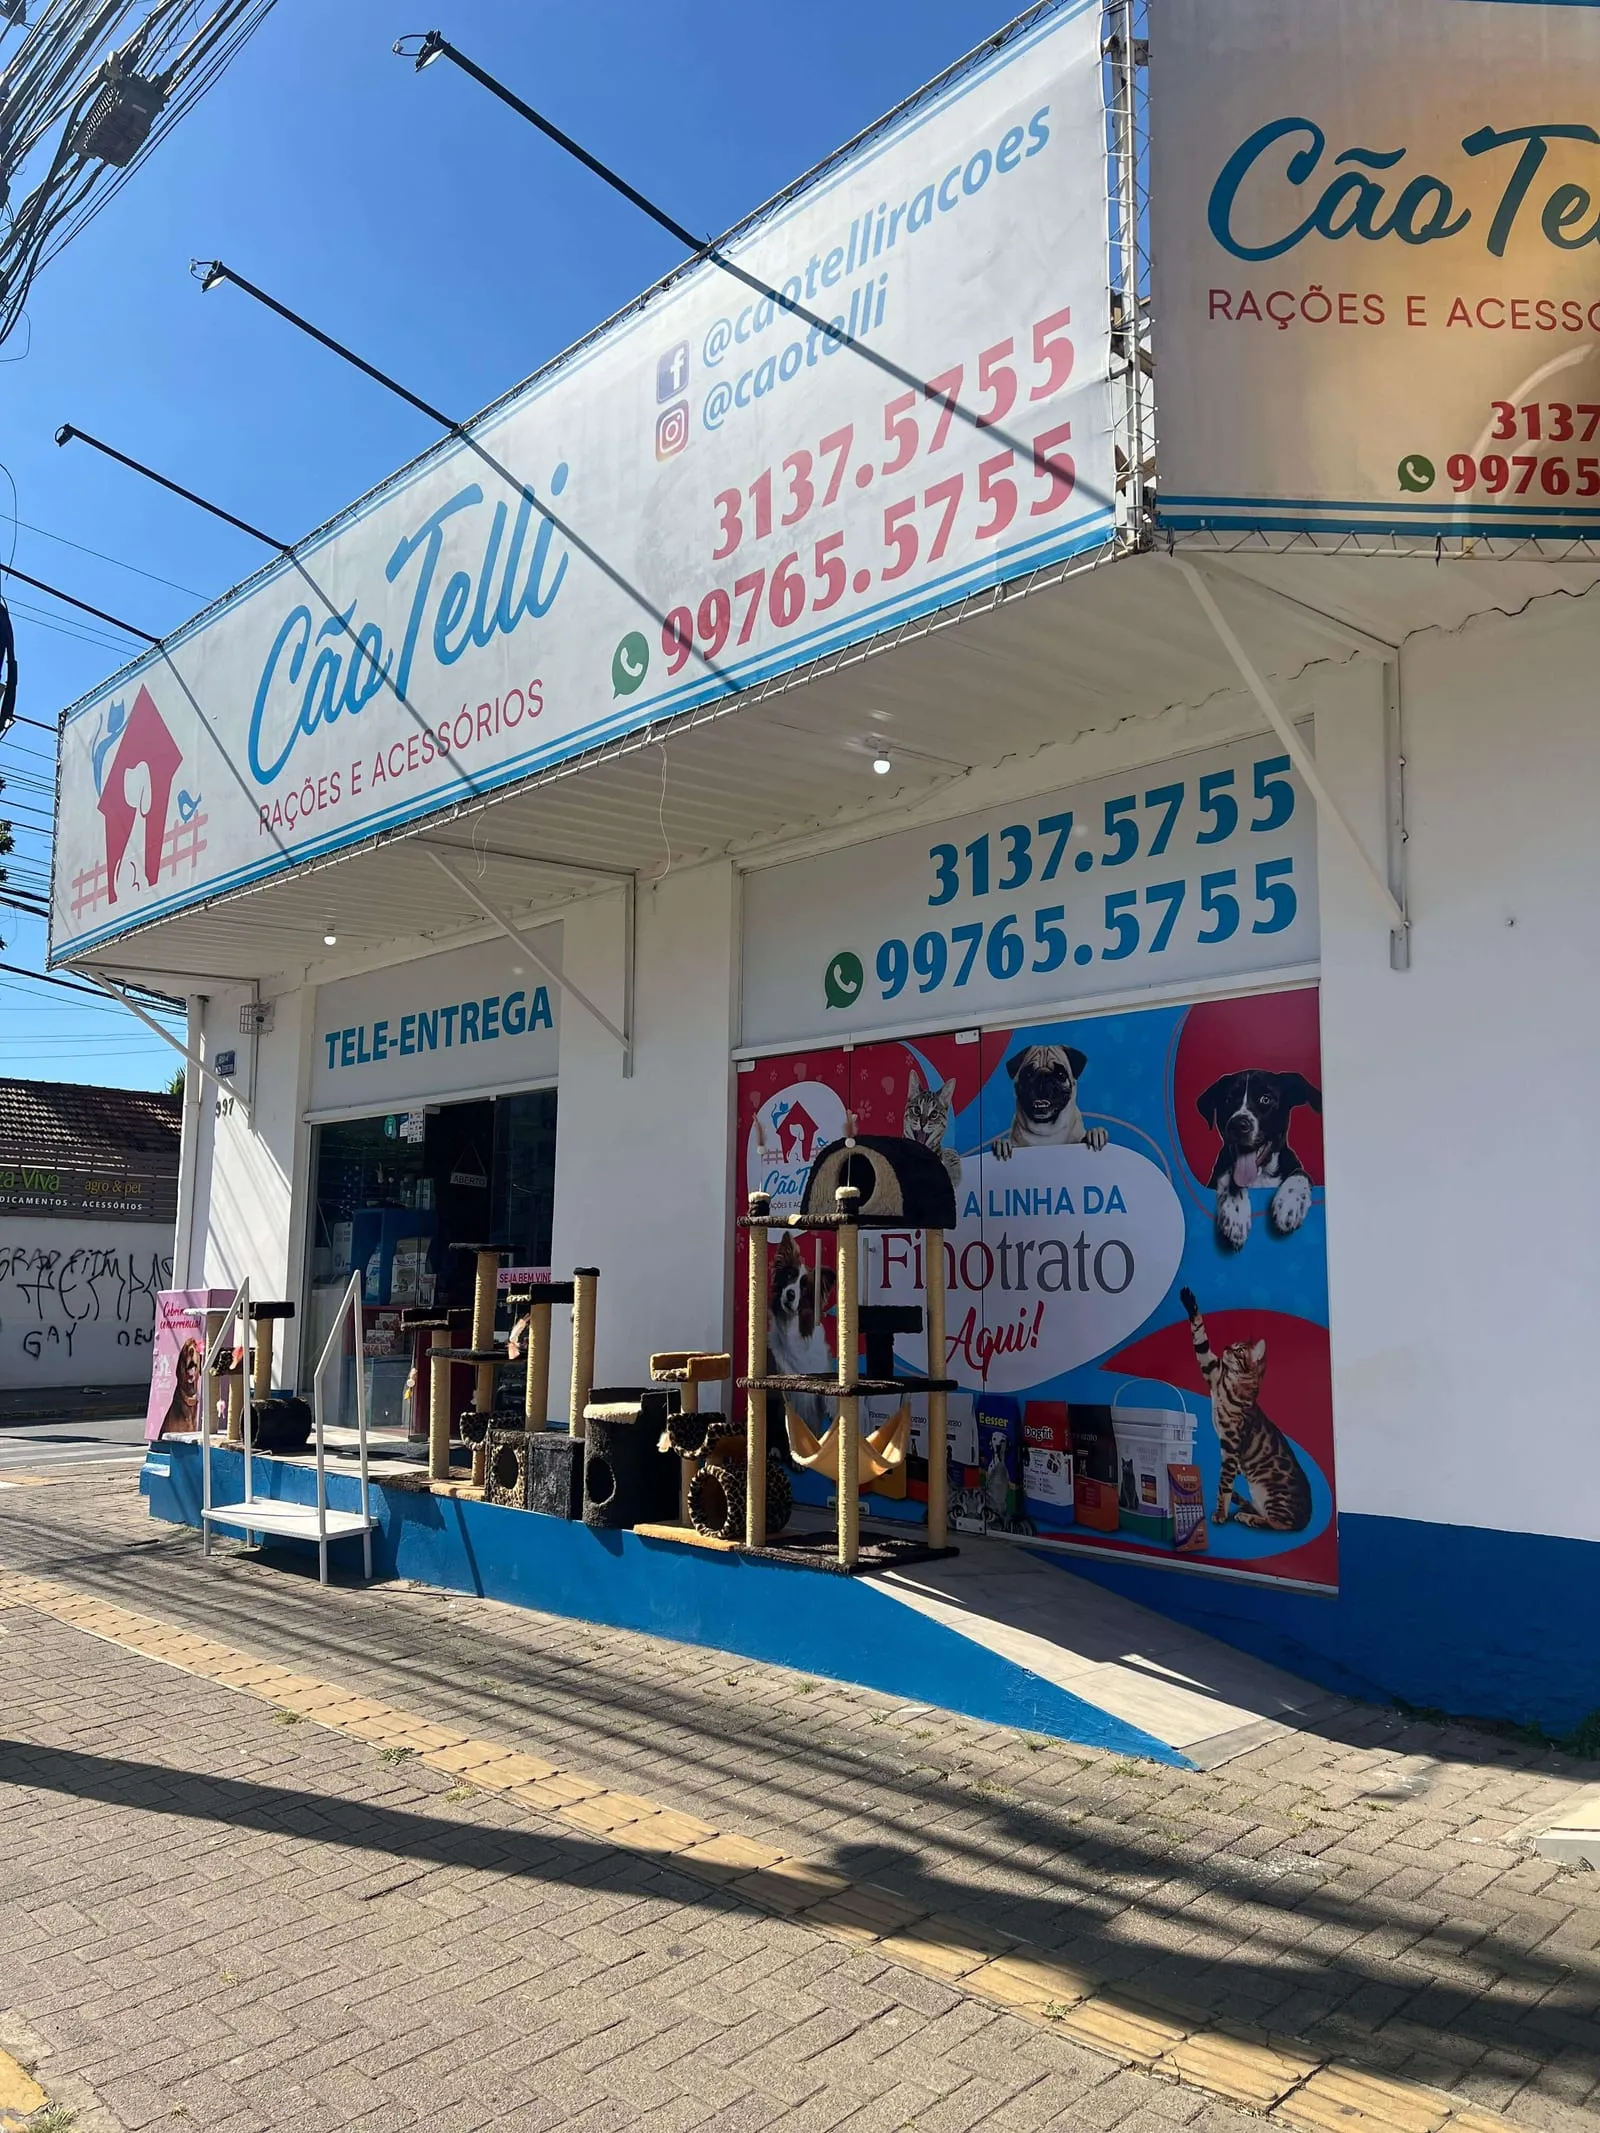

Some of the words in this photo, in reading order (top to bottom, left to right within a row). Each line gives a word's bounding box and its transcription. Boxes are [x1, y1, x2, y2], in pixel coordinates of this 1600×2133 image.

[702, 105, 1052, 368] @caotelliracoes
[1208, 284, 1386, 331] RAÇÕES
[1406, 294, 1428, 327] E
[702, 273, 889, 431] @caotelli
[711, 306, 1076, 561] 3137.5755
[1490, 400, 1600, 443] 3137
[1446, 453, 1600, 497] 99765
[660, 421, 1077, 677] 99765.5755
[258, 771, 341, 838] RAÇÕES
[351, 760, 363, 797] E
[371, 679, 546, 789] ACESSÓRIOS
[927, 754, 1296, 907] 3137.5755
[875, 856, 1298, 1001] 99765.5755
[324, 986, 554, 1070] TELE-ENTREGA
[21, 1168, 60, 1192] Viva
[84, 1180, 110, 1195] agro
[124, 1182, 143, 1199] pet
[962, 1191, 982, 1218] A
[988, 1186, 1076, 1217] LINHA
[1082, 1185, 1128, 1215] DA
[82, 1200, 143, 1211] ACESSÓRIOS
[499, 1273, 517, 1284] SEJA
[519, 1272, 534, 1283] BEM
[23, 1321, 78, 1361] GAY
[945, 1300, 1045, 1382] Aqui!
[978, 1411, 1009, 1428] Eesser
[1024, 1425, 1054, 1442] Dogfit
